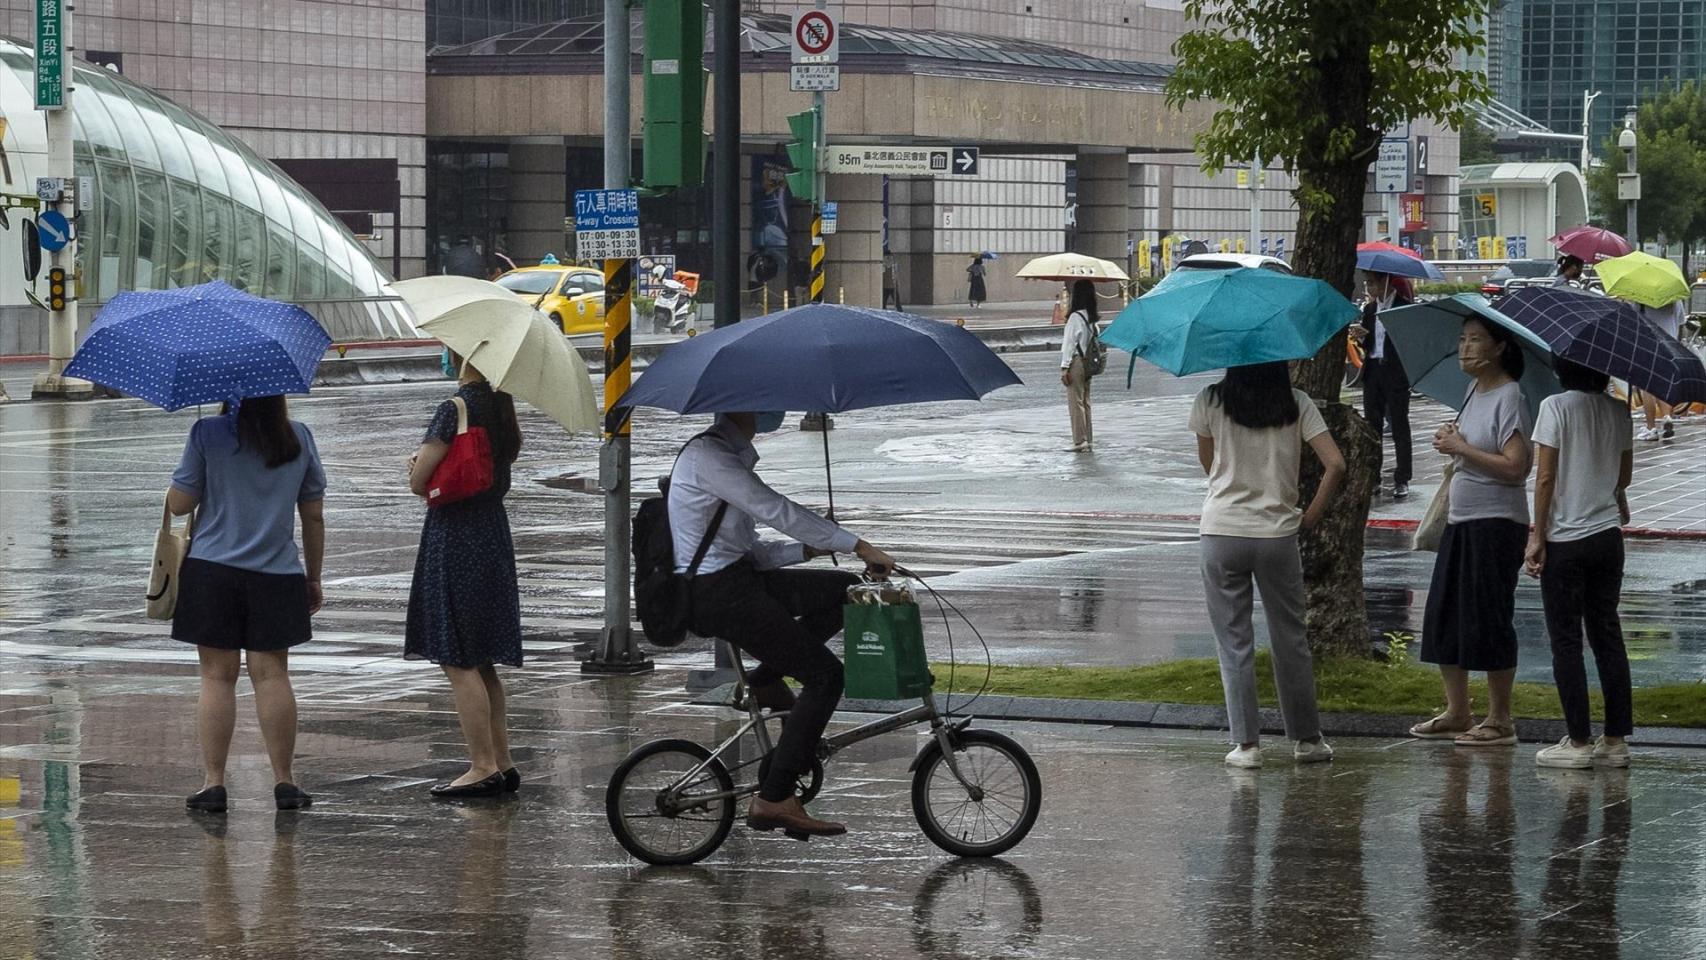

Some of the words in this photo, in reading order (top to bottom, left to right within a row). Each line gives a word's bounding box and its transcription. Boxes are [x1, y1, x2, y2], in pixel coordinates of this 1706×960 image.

[839, 153, 861, 165] 95m
[1419, 142, 1426, 169] 2
[576, 191, 638, 214] 行人專用時相
[1482, 200, 1492, 216] 5
[577, 217, 599, 227] 4-way
[604, 214, 638, 226] Crossing
[946, 215, 951, 226] 5
[580, 231, 636, 240] 07:00-09:30
[581, 240, 637, 249] 11:30-13:30
[581, 249, 637, 259] 16:30-19:00
